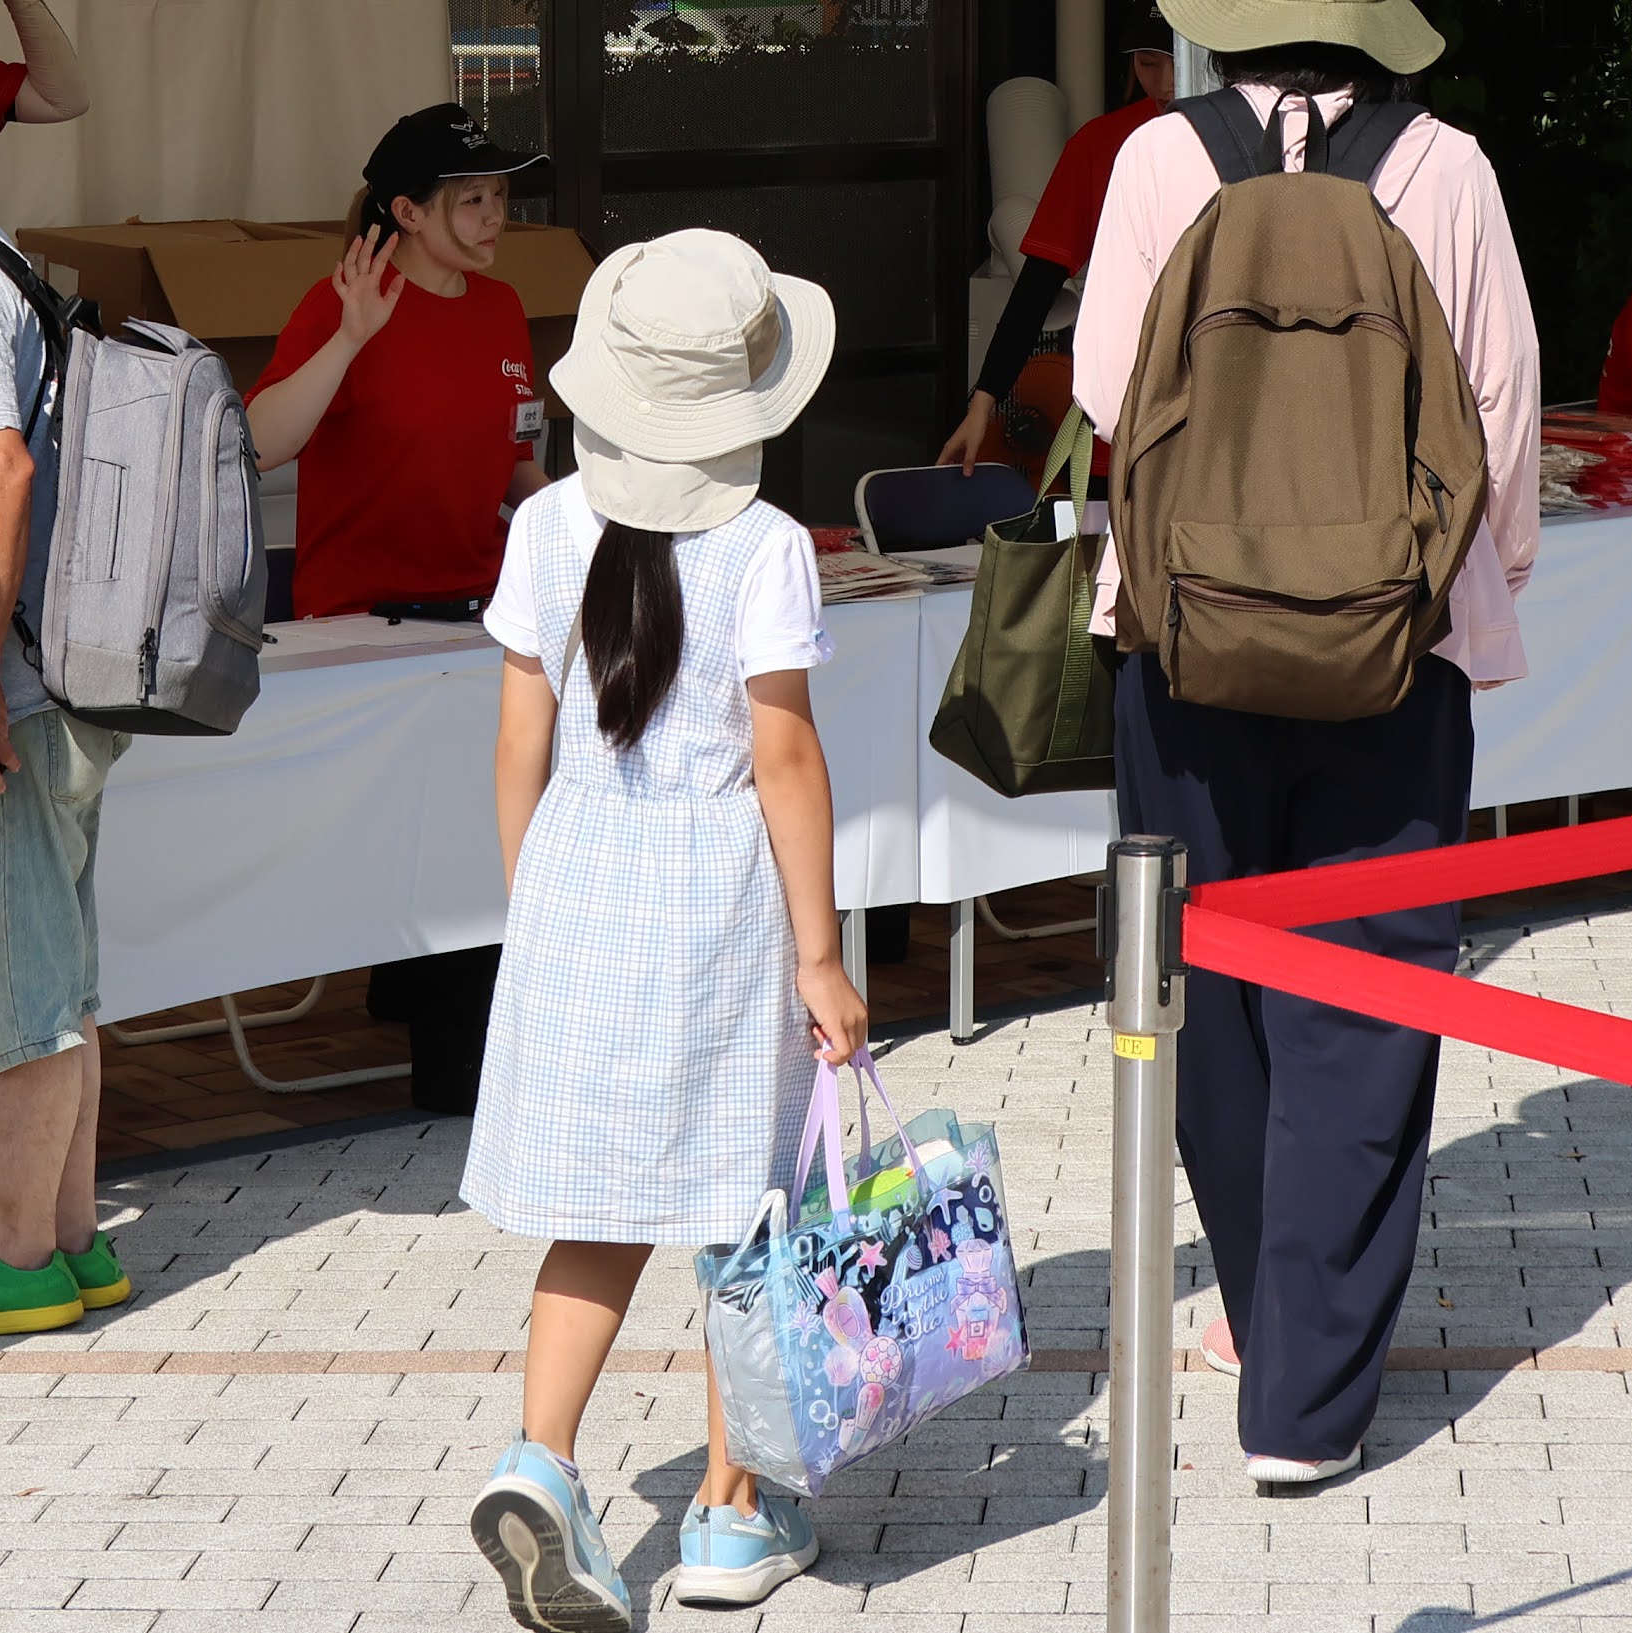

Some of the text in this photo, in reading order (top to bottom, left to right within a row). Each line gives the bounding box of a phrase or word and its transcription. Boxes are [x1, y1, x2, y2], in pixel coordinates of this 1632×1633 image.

[880, 1265, 947, 1315] Dreams
[892, 1288, 949, 1325] in the
